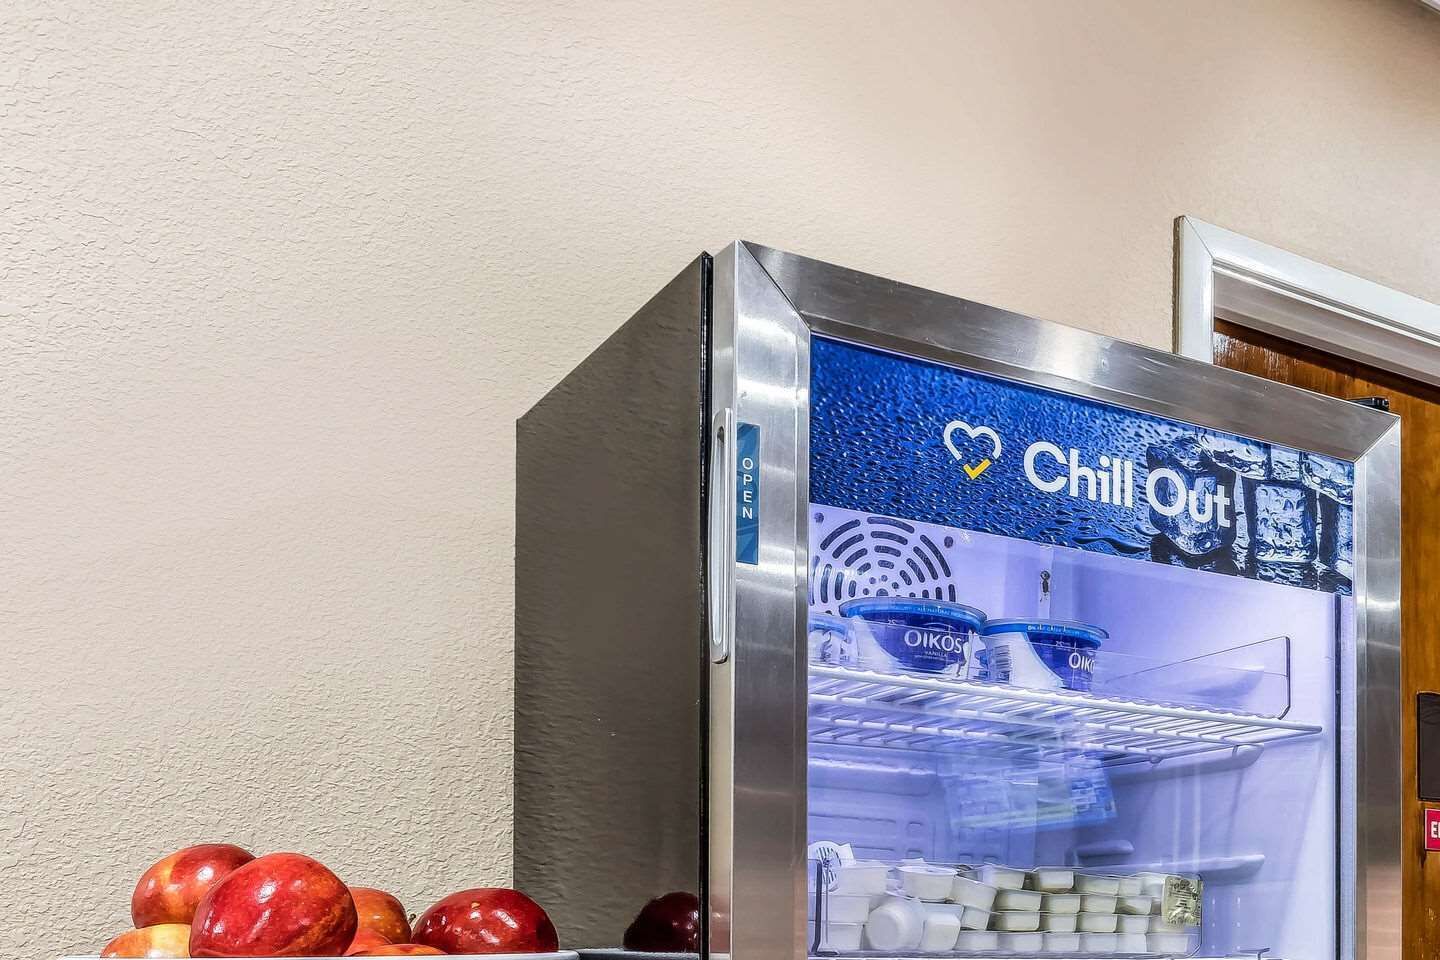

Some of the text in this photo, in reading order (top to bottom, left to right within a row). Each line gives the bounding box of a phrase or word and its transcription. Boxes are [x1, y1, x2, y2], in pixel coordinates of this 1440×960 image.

[742, 457, 754, 520] OPEN
[1023, 441, 1231, 528] Chill Out
[904, 629, 963, 655] OIKOS
